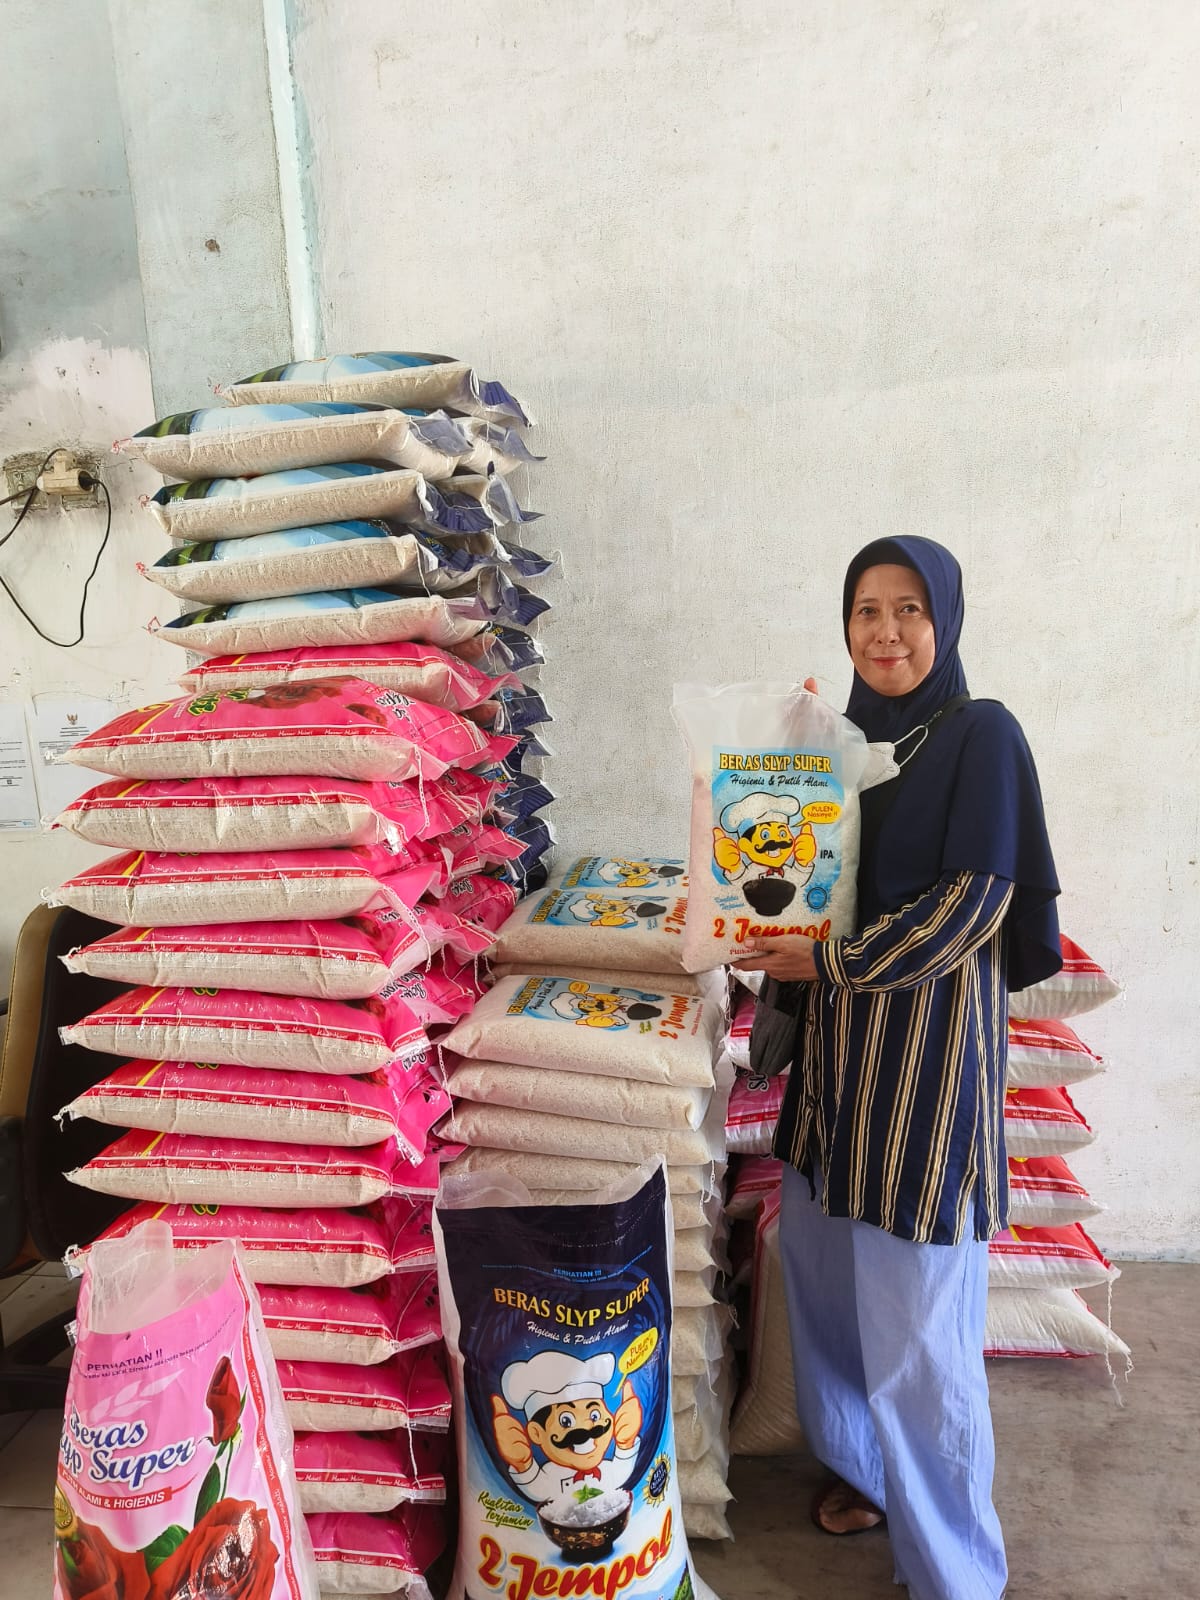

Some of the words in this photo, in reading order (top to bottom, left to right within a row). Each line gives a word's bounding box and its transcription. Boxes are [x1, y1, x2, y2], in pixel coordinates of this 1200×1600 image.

[720, 753, 761, 771] BERAS
[763, 755, 791, 771] SLYP
[794, 754, 833, 773] SUPER
[730, 774, 765, 787] Higienis
[768, 775, 775, 786] &
[778, 774, 801, 787] Putih
[802, 776, 828, 787] Alami
[820, 850, 834, 859] IPA
[713, 918, 725, 938] 2
[493, 1287, 551, 1318] BERAS
[555, 1304, 601, 1328] SLYP
[605, 1277, 650, 1321] SUPER
[526, 1321, 560, 1341] Higienis
[562, 1333, 570, 1344] &
[574, 1331, 600, 1345] Putih
[602, 1319, 630, 1339] Alami
[87, 1352, 153, 1372] PERHATIAN
[71, 1402, 145, 1449] Beras
[90, 1439, 195, 1488] Super
[103, 1499, 111, 1509] &
[114, 1491, 165, 1509] HIGIENIS
[478, 1490, 523, 1512] Kualitas
[486, 1507, 534, 1528] Terjamin
[478, 1536, 504, 1586] 2
[508, 1509, 673, 1600] Jempol
